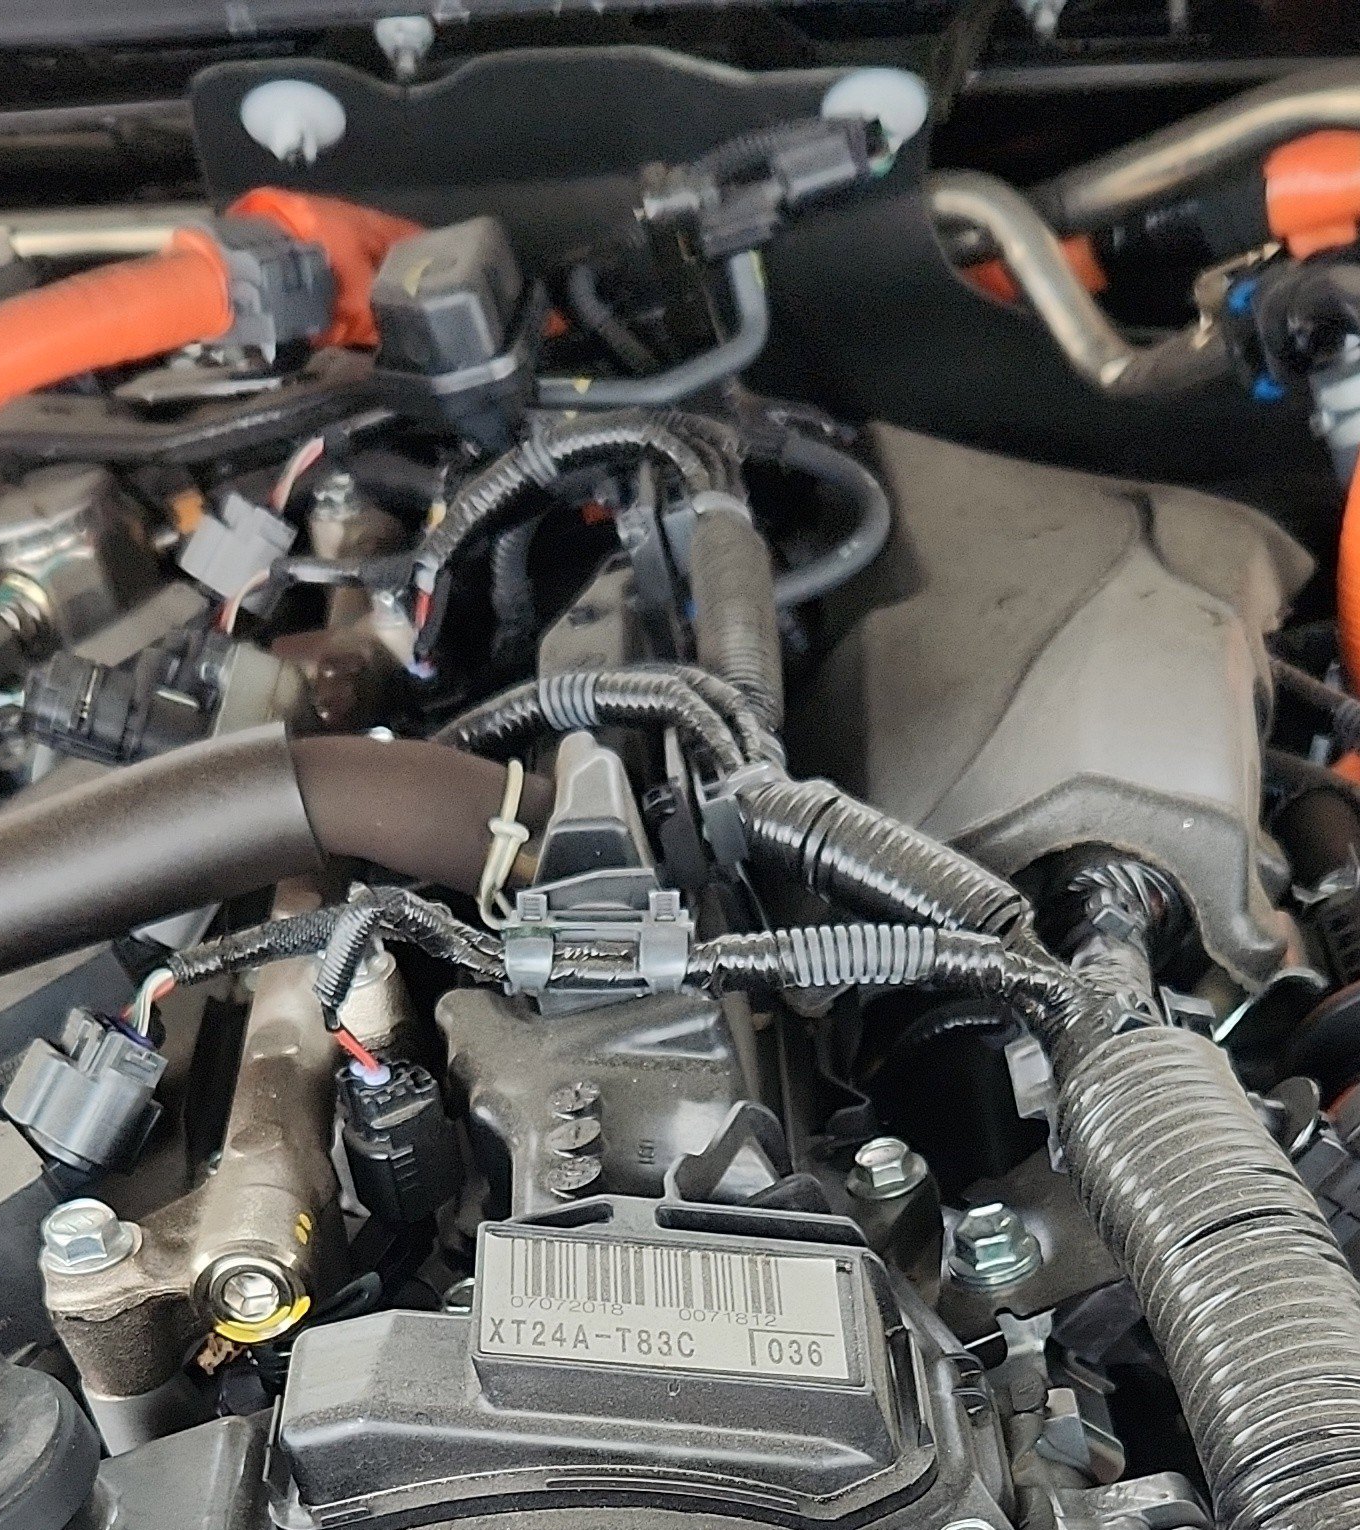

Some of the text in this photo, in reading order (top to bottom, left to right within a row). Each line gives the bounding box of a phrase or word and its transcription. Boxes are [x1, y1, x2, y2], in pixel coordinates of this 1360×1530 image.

[510, 1295, 778, 1327] 07072018 0071812
[488, 1317, 824, 1367] XT24A-T83C 036
